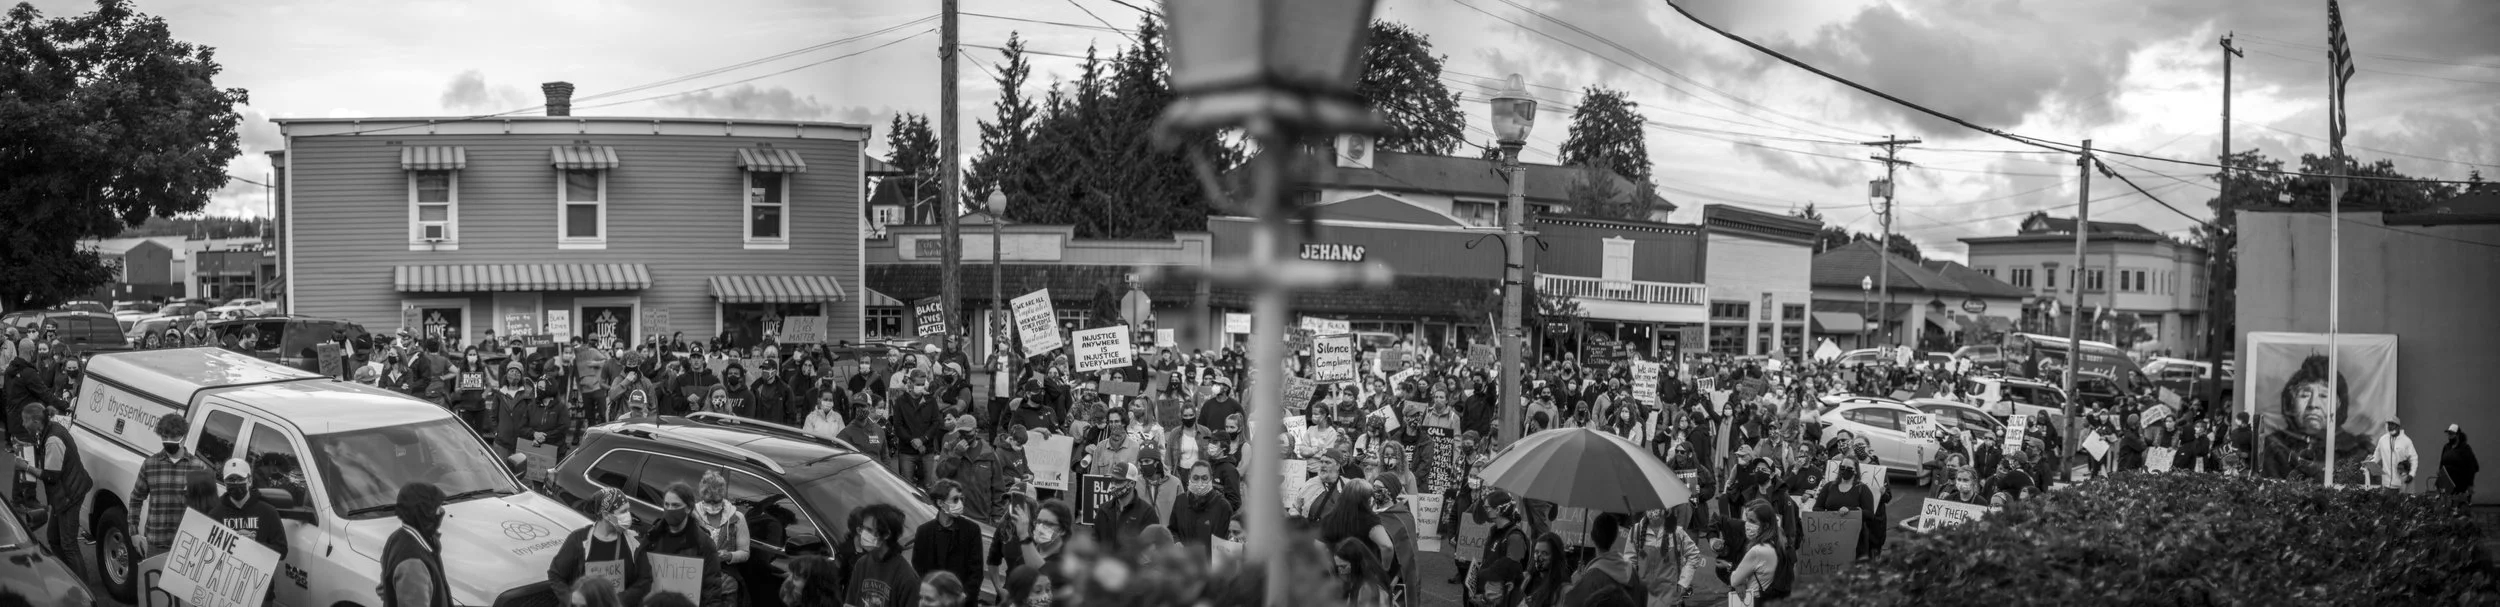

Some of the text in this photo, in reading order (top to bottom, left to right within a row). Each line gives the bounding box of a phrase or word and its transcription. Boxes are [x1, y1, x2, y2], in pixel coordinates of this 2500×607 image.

[1301, 244, 1365, 261] JEHANS
[917, 303, 942, 316] BLACK
[920, 314, 941, 325] LIVES
[426, 324, 447, 340] LUXE
[598, 323, 617, 337] LUXE
[762, 321, 780, 336] LUXE
[598, 337, 617, 350] SALO
[788, 333, 815, 342] MATTER
[1081, 339, 1120, 349] ANYWHERE
[1082, 332, 1117, 342] INJUSTICE
[1317, 342, 1349, 354] Silence
[1080, 357, 1129, 368] EVERYWHERE.
[1083, 351, 1119, 361] INJUSTICE
[1907, 416, 1927, 425] RACISM
[1428, 427, 1445, 436] CALL
[1909, 430, 1935, 439] PANDEMIC
[1827, 460, 1882, 489] BCK
[1094, 480, 1113, 494] BLA
[1093, 493, 1114, 509] LIV
[1926, 503, 1969, 521] SAY THEIR
[1807, 517, 1848, 533] Black
[207, 525, 239, 555] HAVE
[1460, 535, 1485, 548] BLAC
[511, 539, 566, 556] thyssenk
[168, 530, 269, 607] EMPATHY
[651, 556, 697, 580] White
[1799, 561, 1841, 575] Matter
